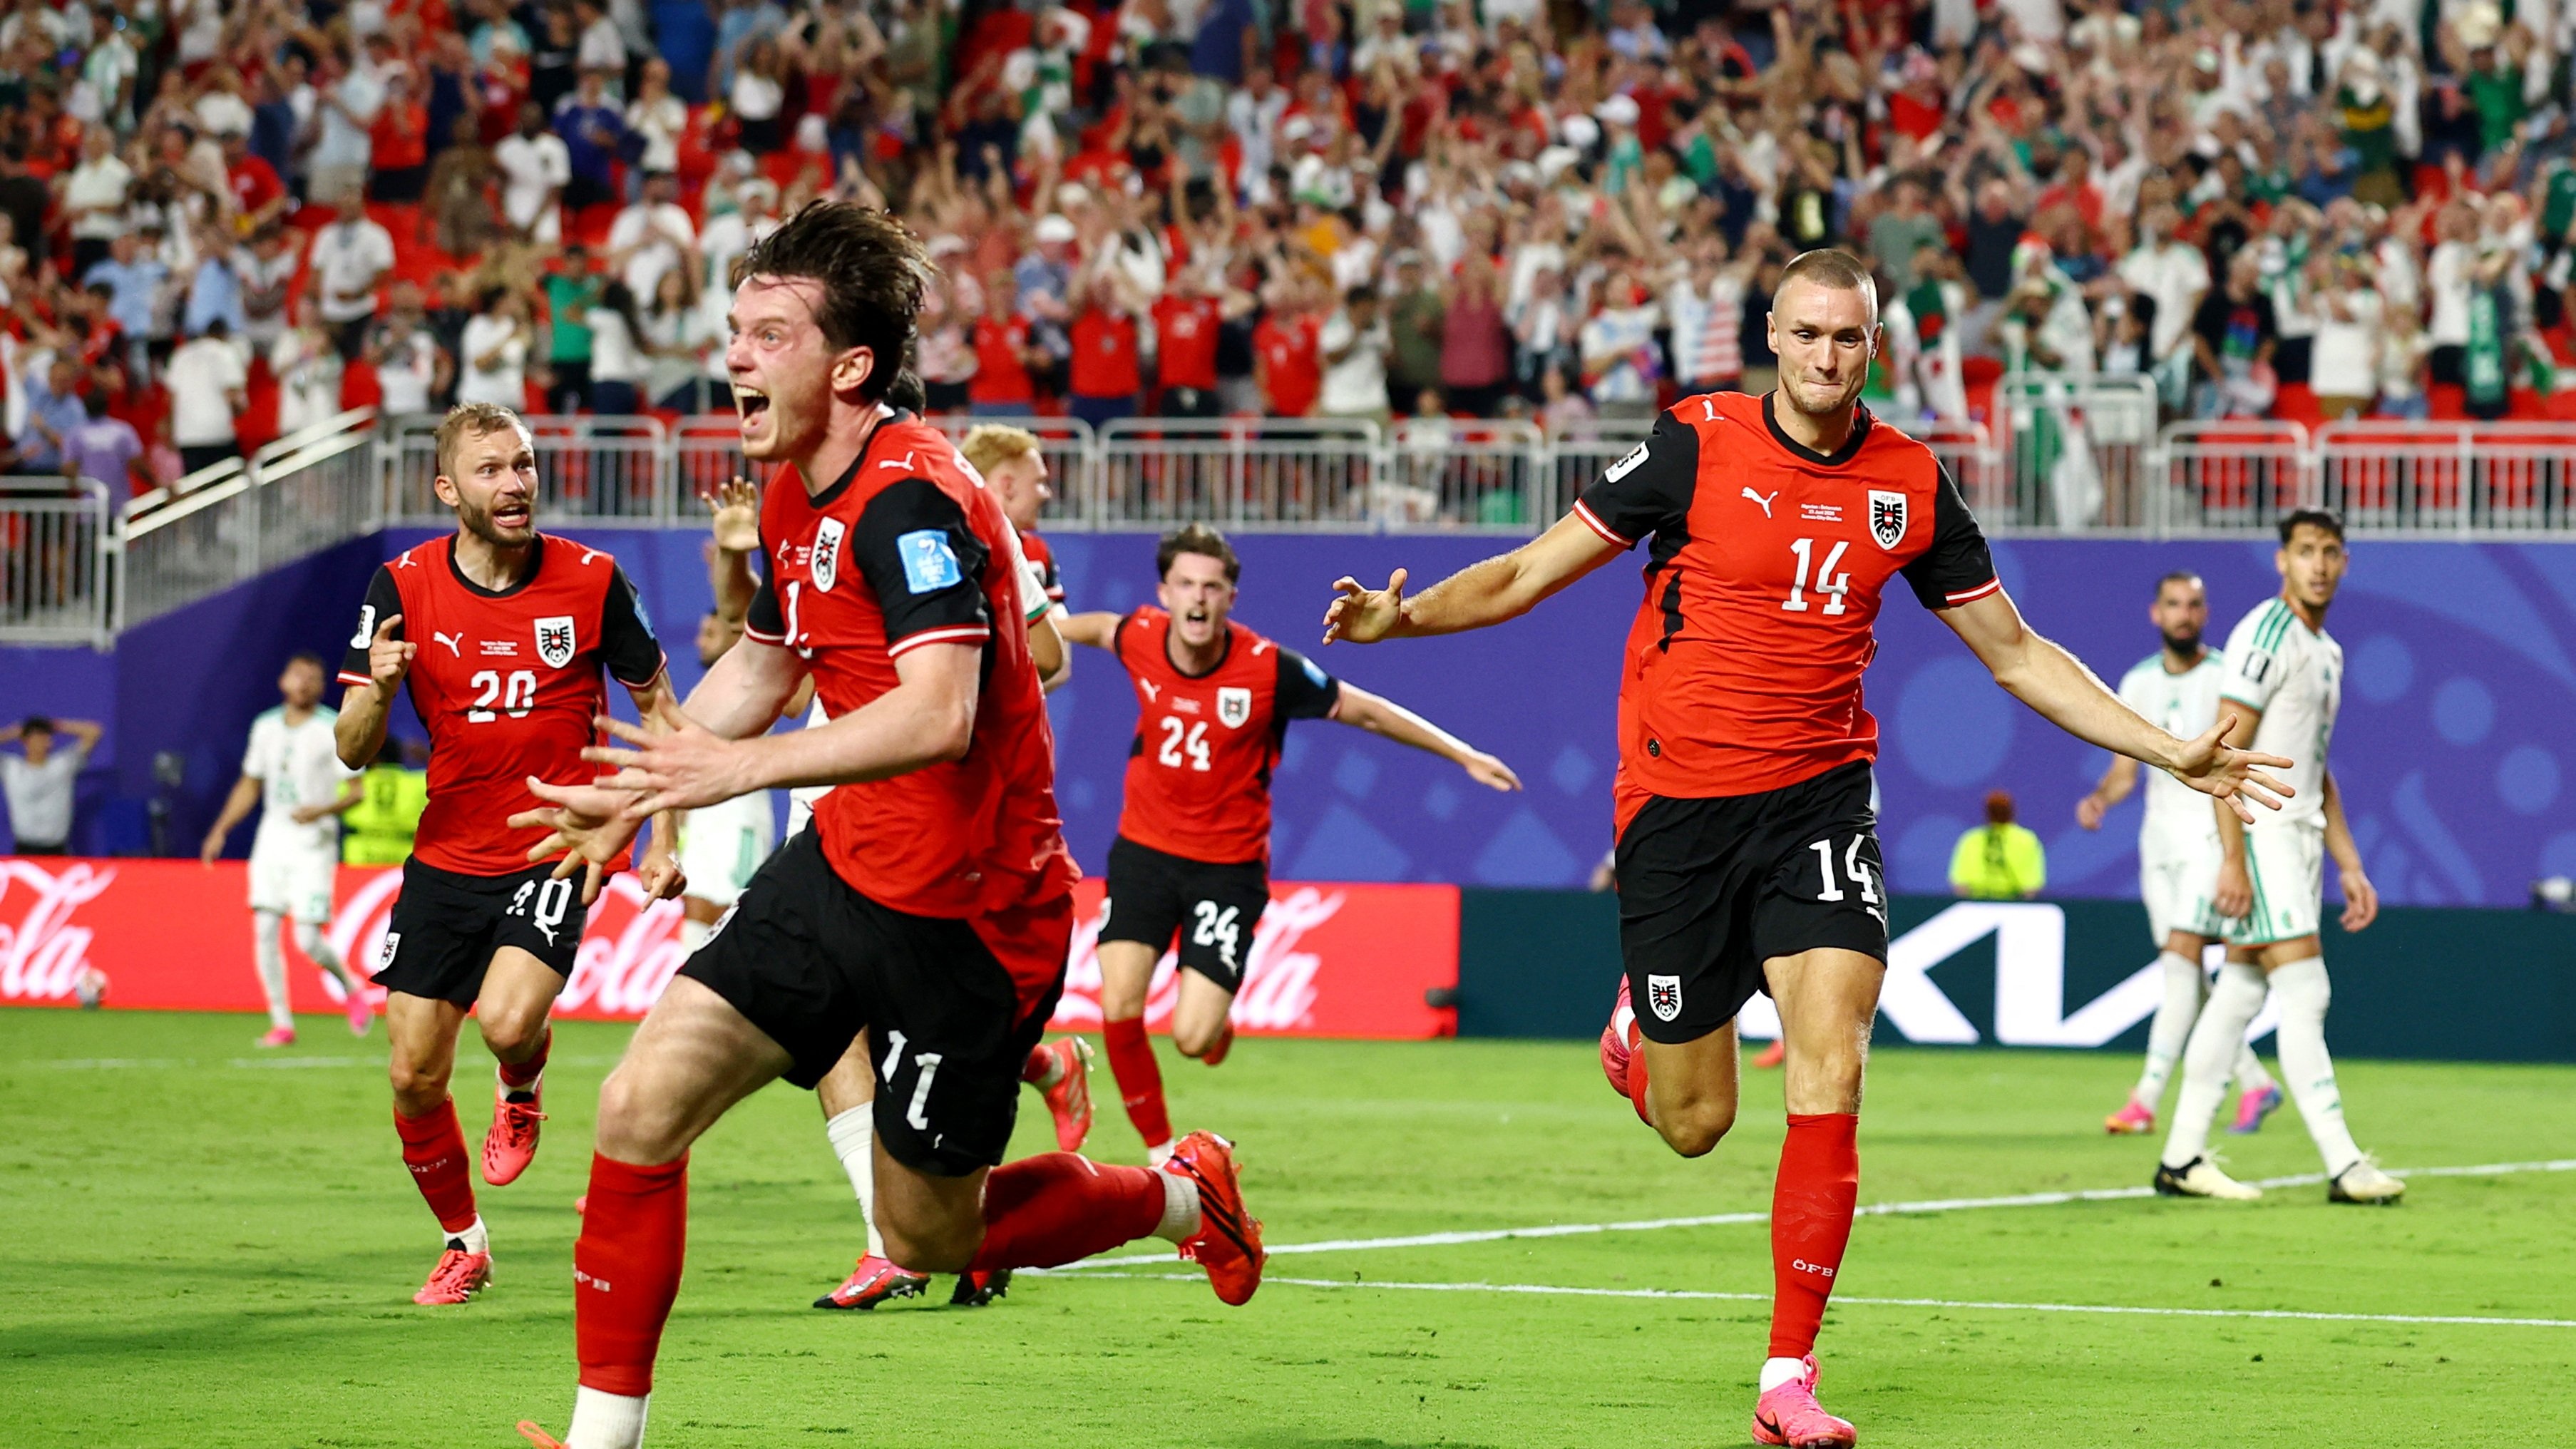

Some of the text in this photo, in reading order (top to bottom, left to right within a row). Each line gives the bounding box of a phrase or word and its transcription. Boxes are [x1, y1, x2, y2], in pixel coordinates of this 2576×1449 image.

[1782, 538, 1851, 615] 14
[468, 670, 537, 723] 20
[1158, 715, 1211, 772] 24
[1809, 833, 1879, 904] 14
[1193, 899, 1241, 956] 24
[1792, 1258, 1833, 1277] ÖFB
